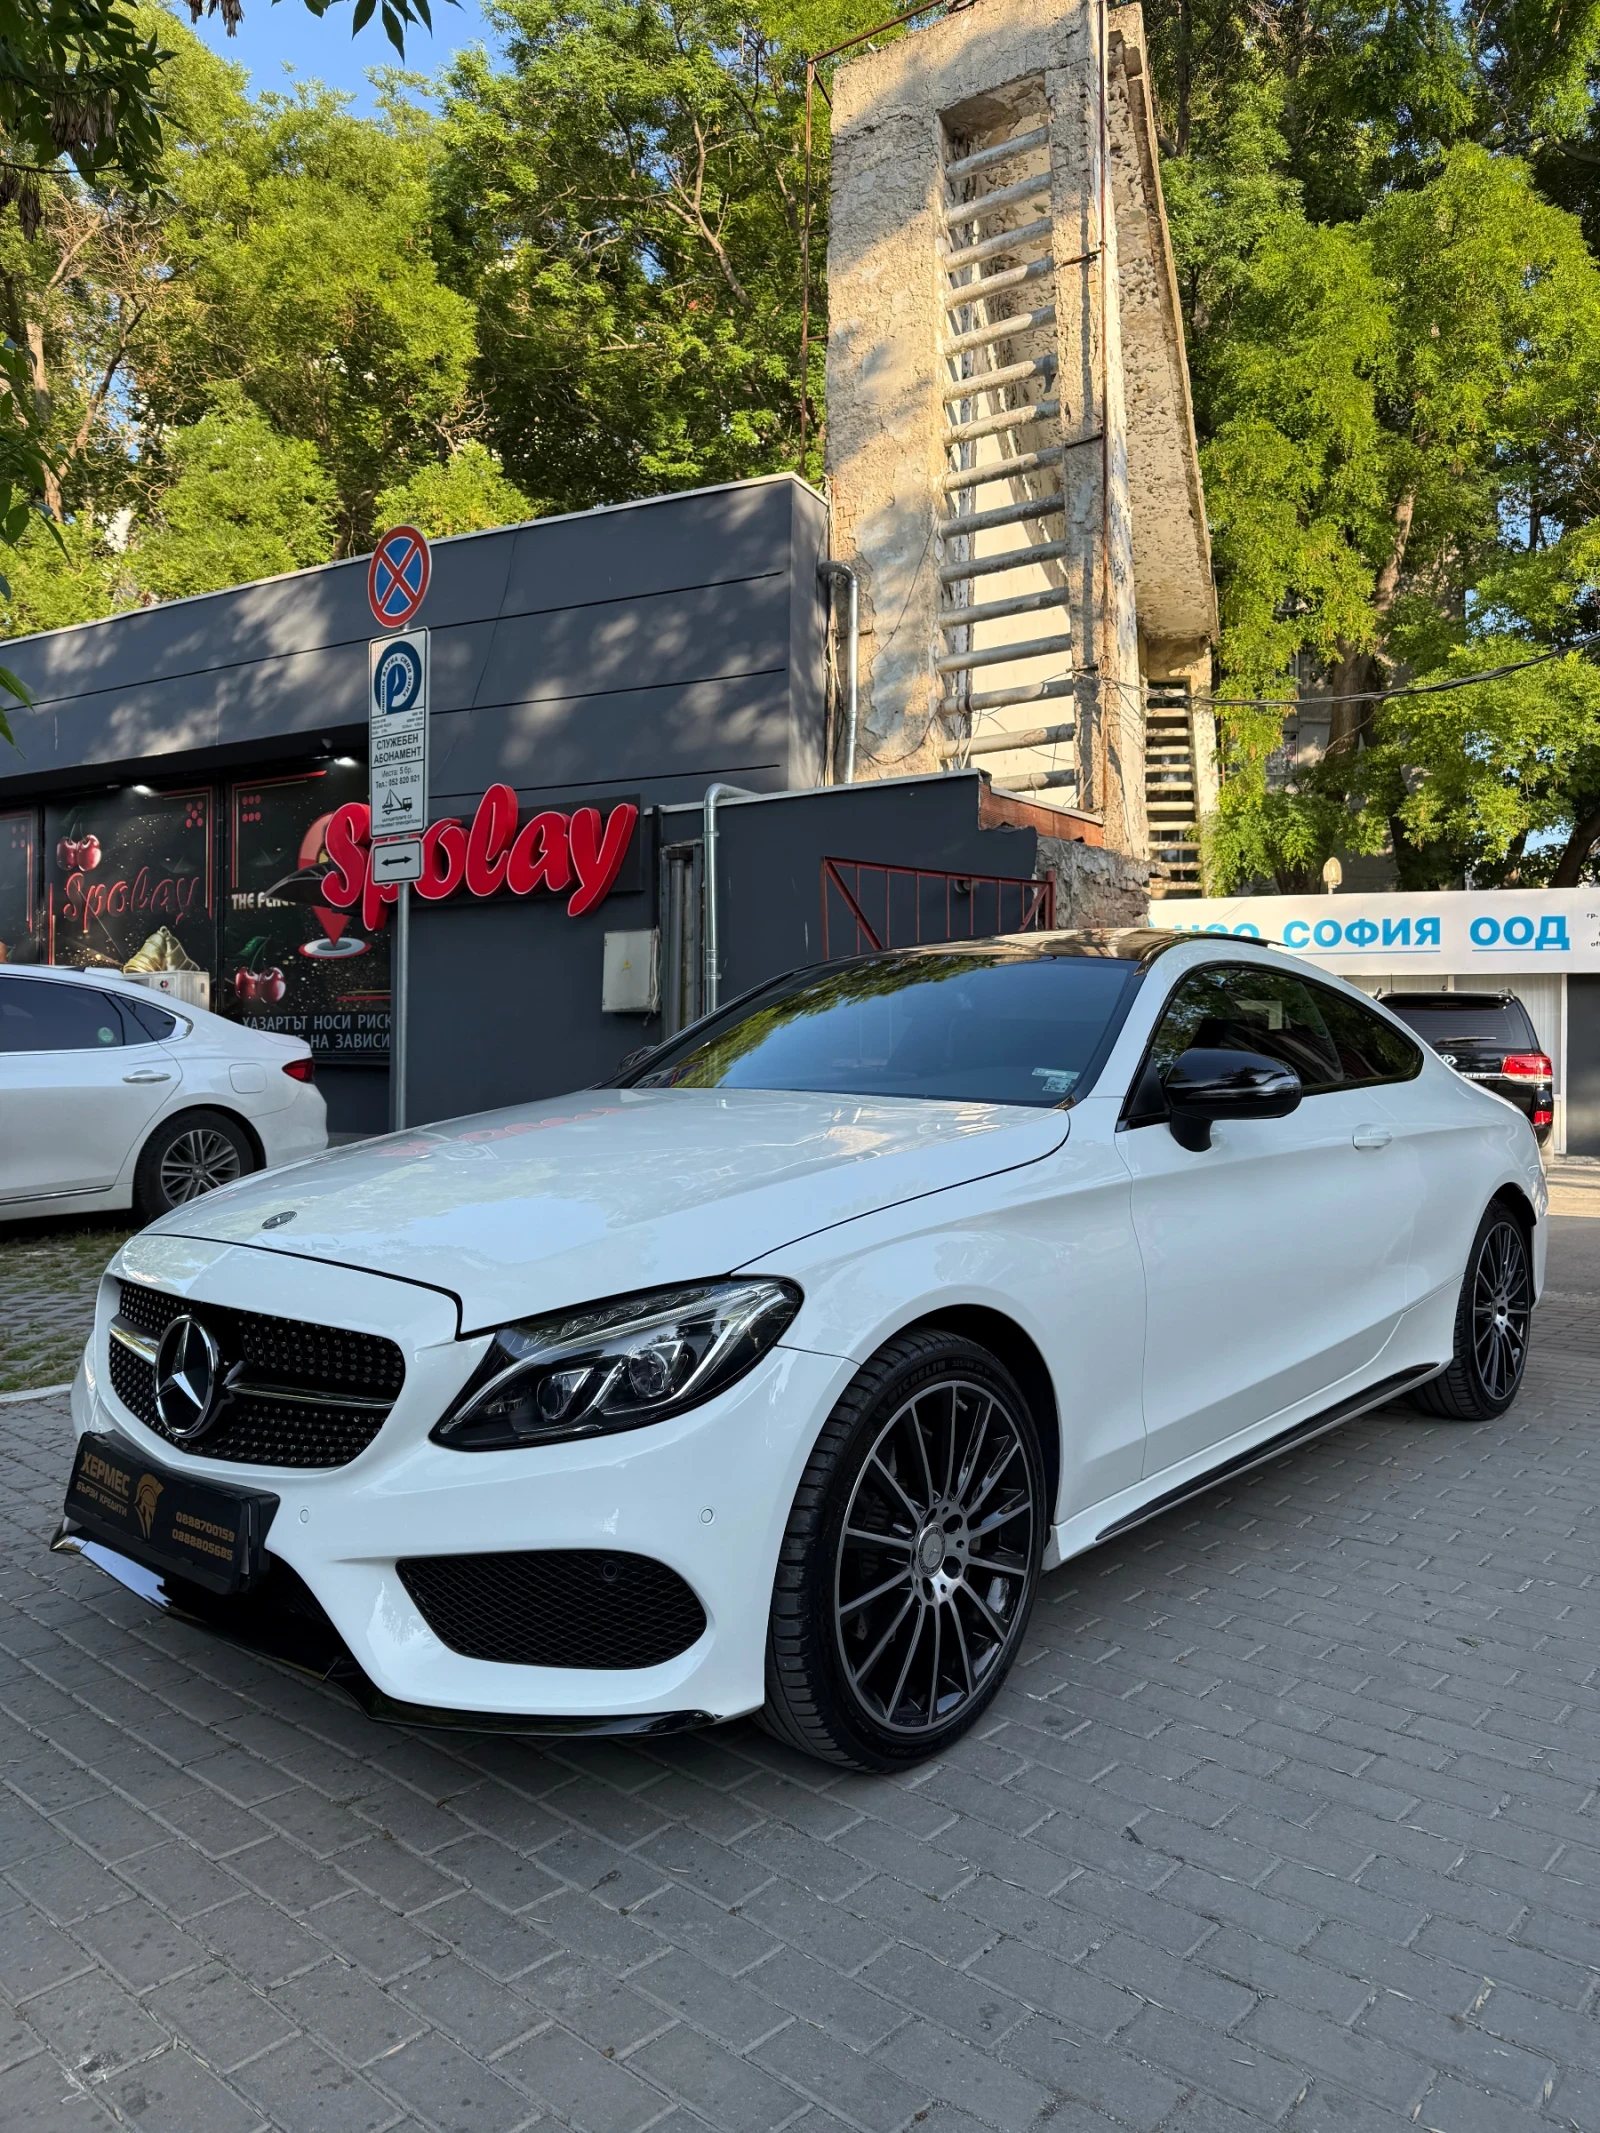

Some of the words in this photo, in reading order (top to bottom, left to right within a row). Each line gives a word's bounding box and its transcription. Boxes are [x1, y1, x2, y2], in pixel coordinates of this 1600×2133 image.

[376, 733, 419, 750] СЛУЖЕБЕН
[374, 746, 422, 764] АБОНАМЕНТ
[388, 778, 399, 787] 052
[399, 776, 410, 785] 820
[410, 774, 420, 783] 921
[399, 766, 404, 775] 5
[63, 866, 199, 934] Spolay
[231, 893, 255, 910] THE
[1283, 916, 1441, 949] СОФИЯ
[1469, 916, 1570, 951] ООД
[242, 1016, 308, 1031] ХАЗАРТЪТ
[313, 1015, 351, 1030] НОСИ
[357, 1014, 392, 1030] РИСК
[311, 1034, 329, 1049] НА
[887, 1360, 946, 1405] MICHELIN
[80, 1450, 131, 1497] ХЕРМЕС
[76, 1481, 98, 1500] БЪРЗИ
[99, 1493, 128, 1517] КРЕДИТИ
[175, 1511, 235, 1543] 0888700159
[172, 1528, 233, 1561] 0888805685
